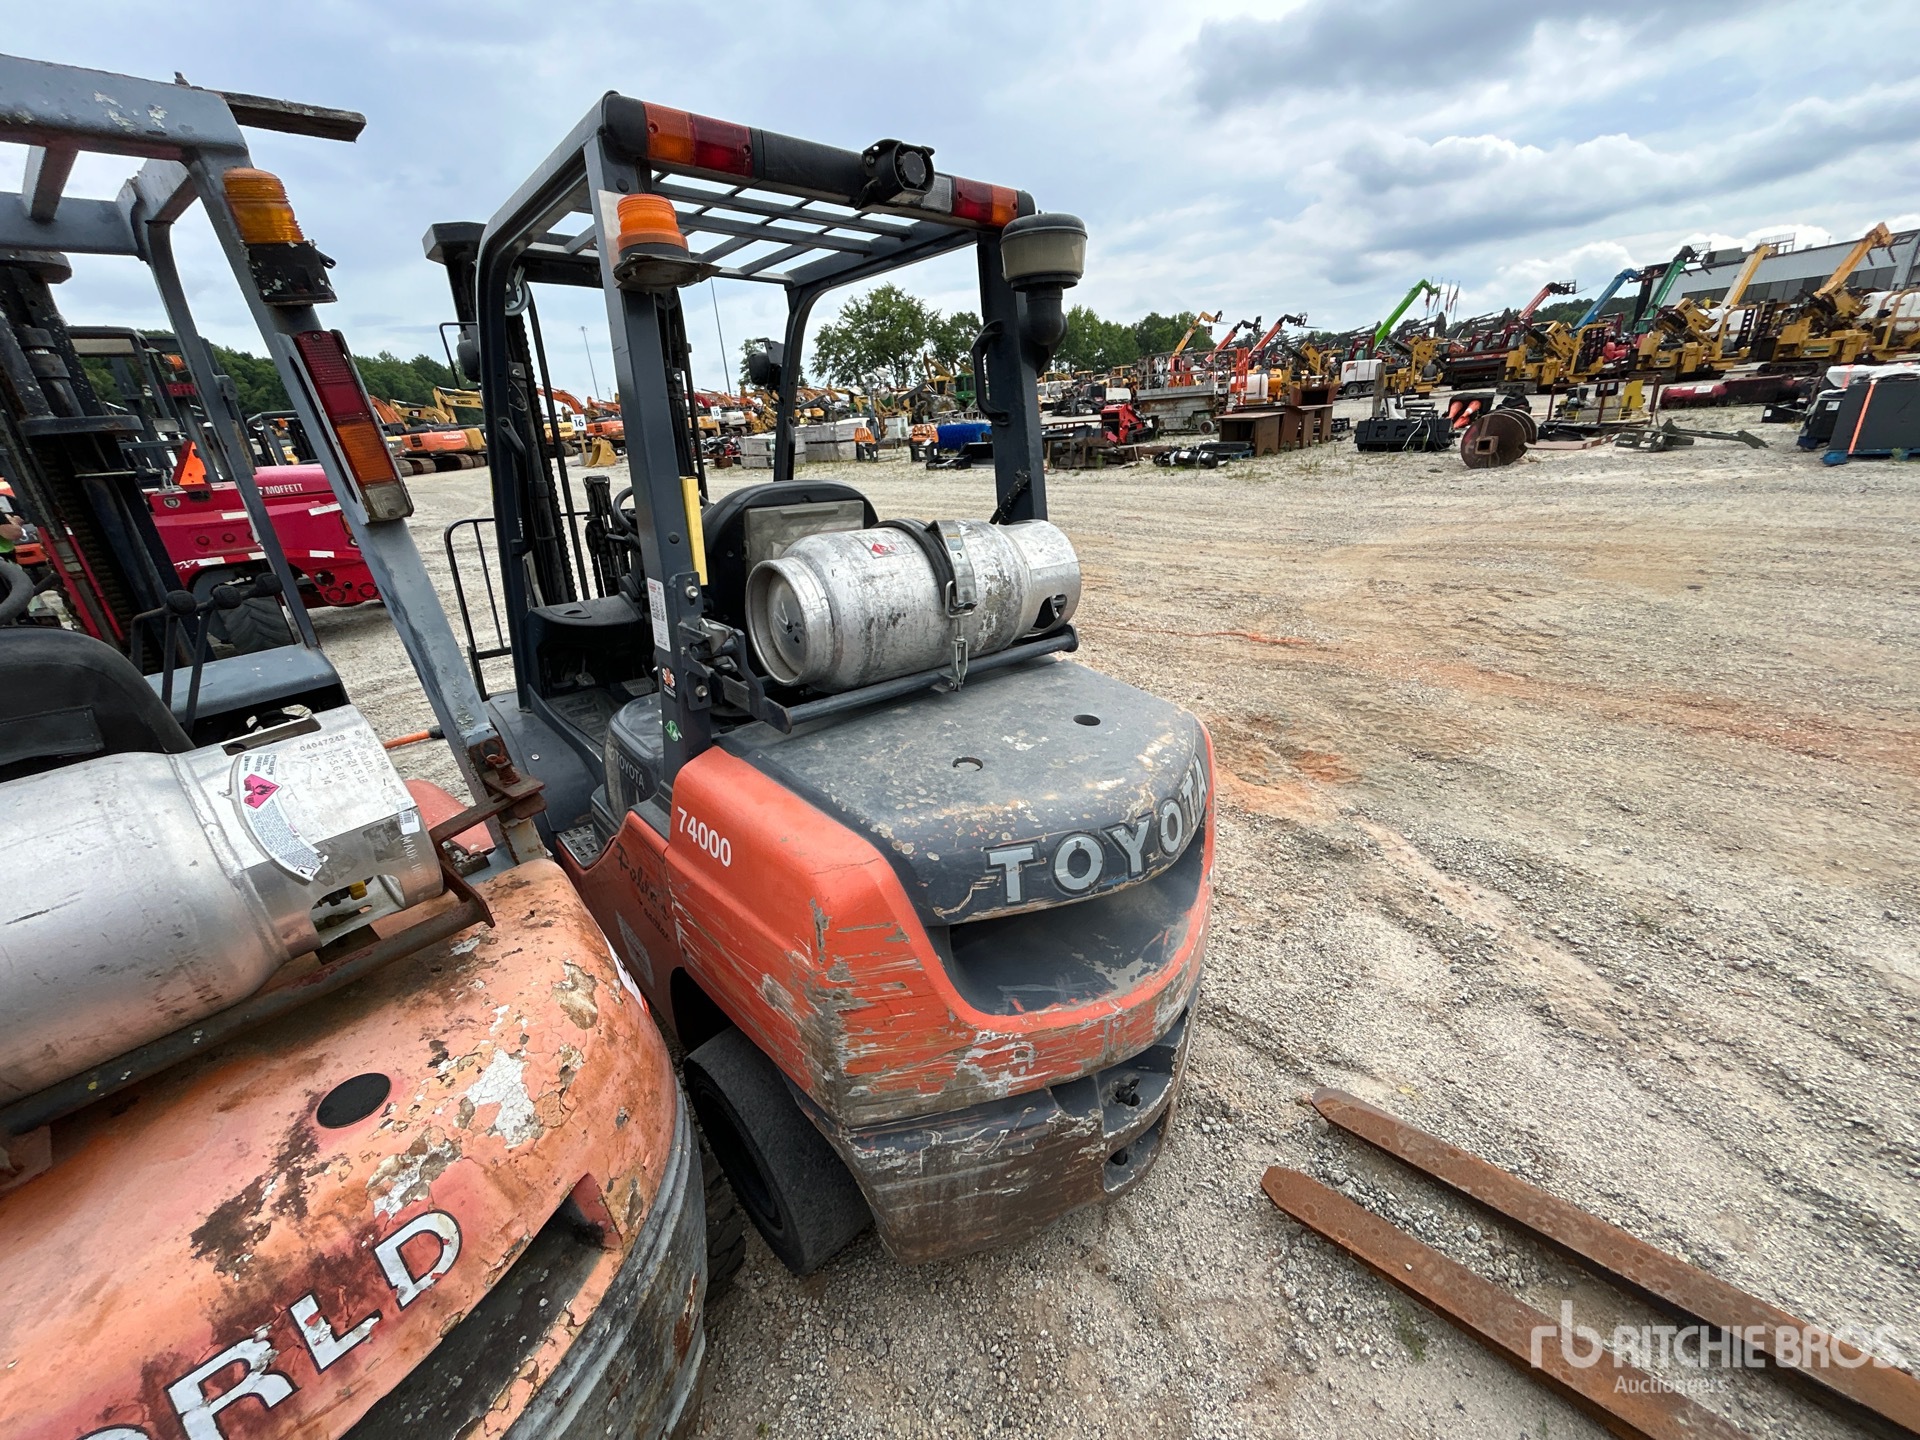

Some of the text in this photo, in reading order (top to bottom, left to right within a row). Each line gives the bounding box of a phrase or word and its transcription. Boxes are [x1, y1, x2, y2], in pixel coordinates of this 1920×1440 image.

[574, 419, 584, 427] 16
[265, 483, 303, 494] MOFFETT
[614, 749, 645, 790] TOYOTA
[401, 835, 419, 862] MADE
[677, 805, 732, 868] 74000
[988, 753, 1209, 904] TOYOTA
[76, 1209, 464, 1440] RLD
